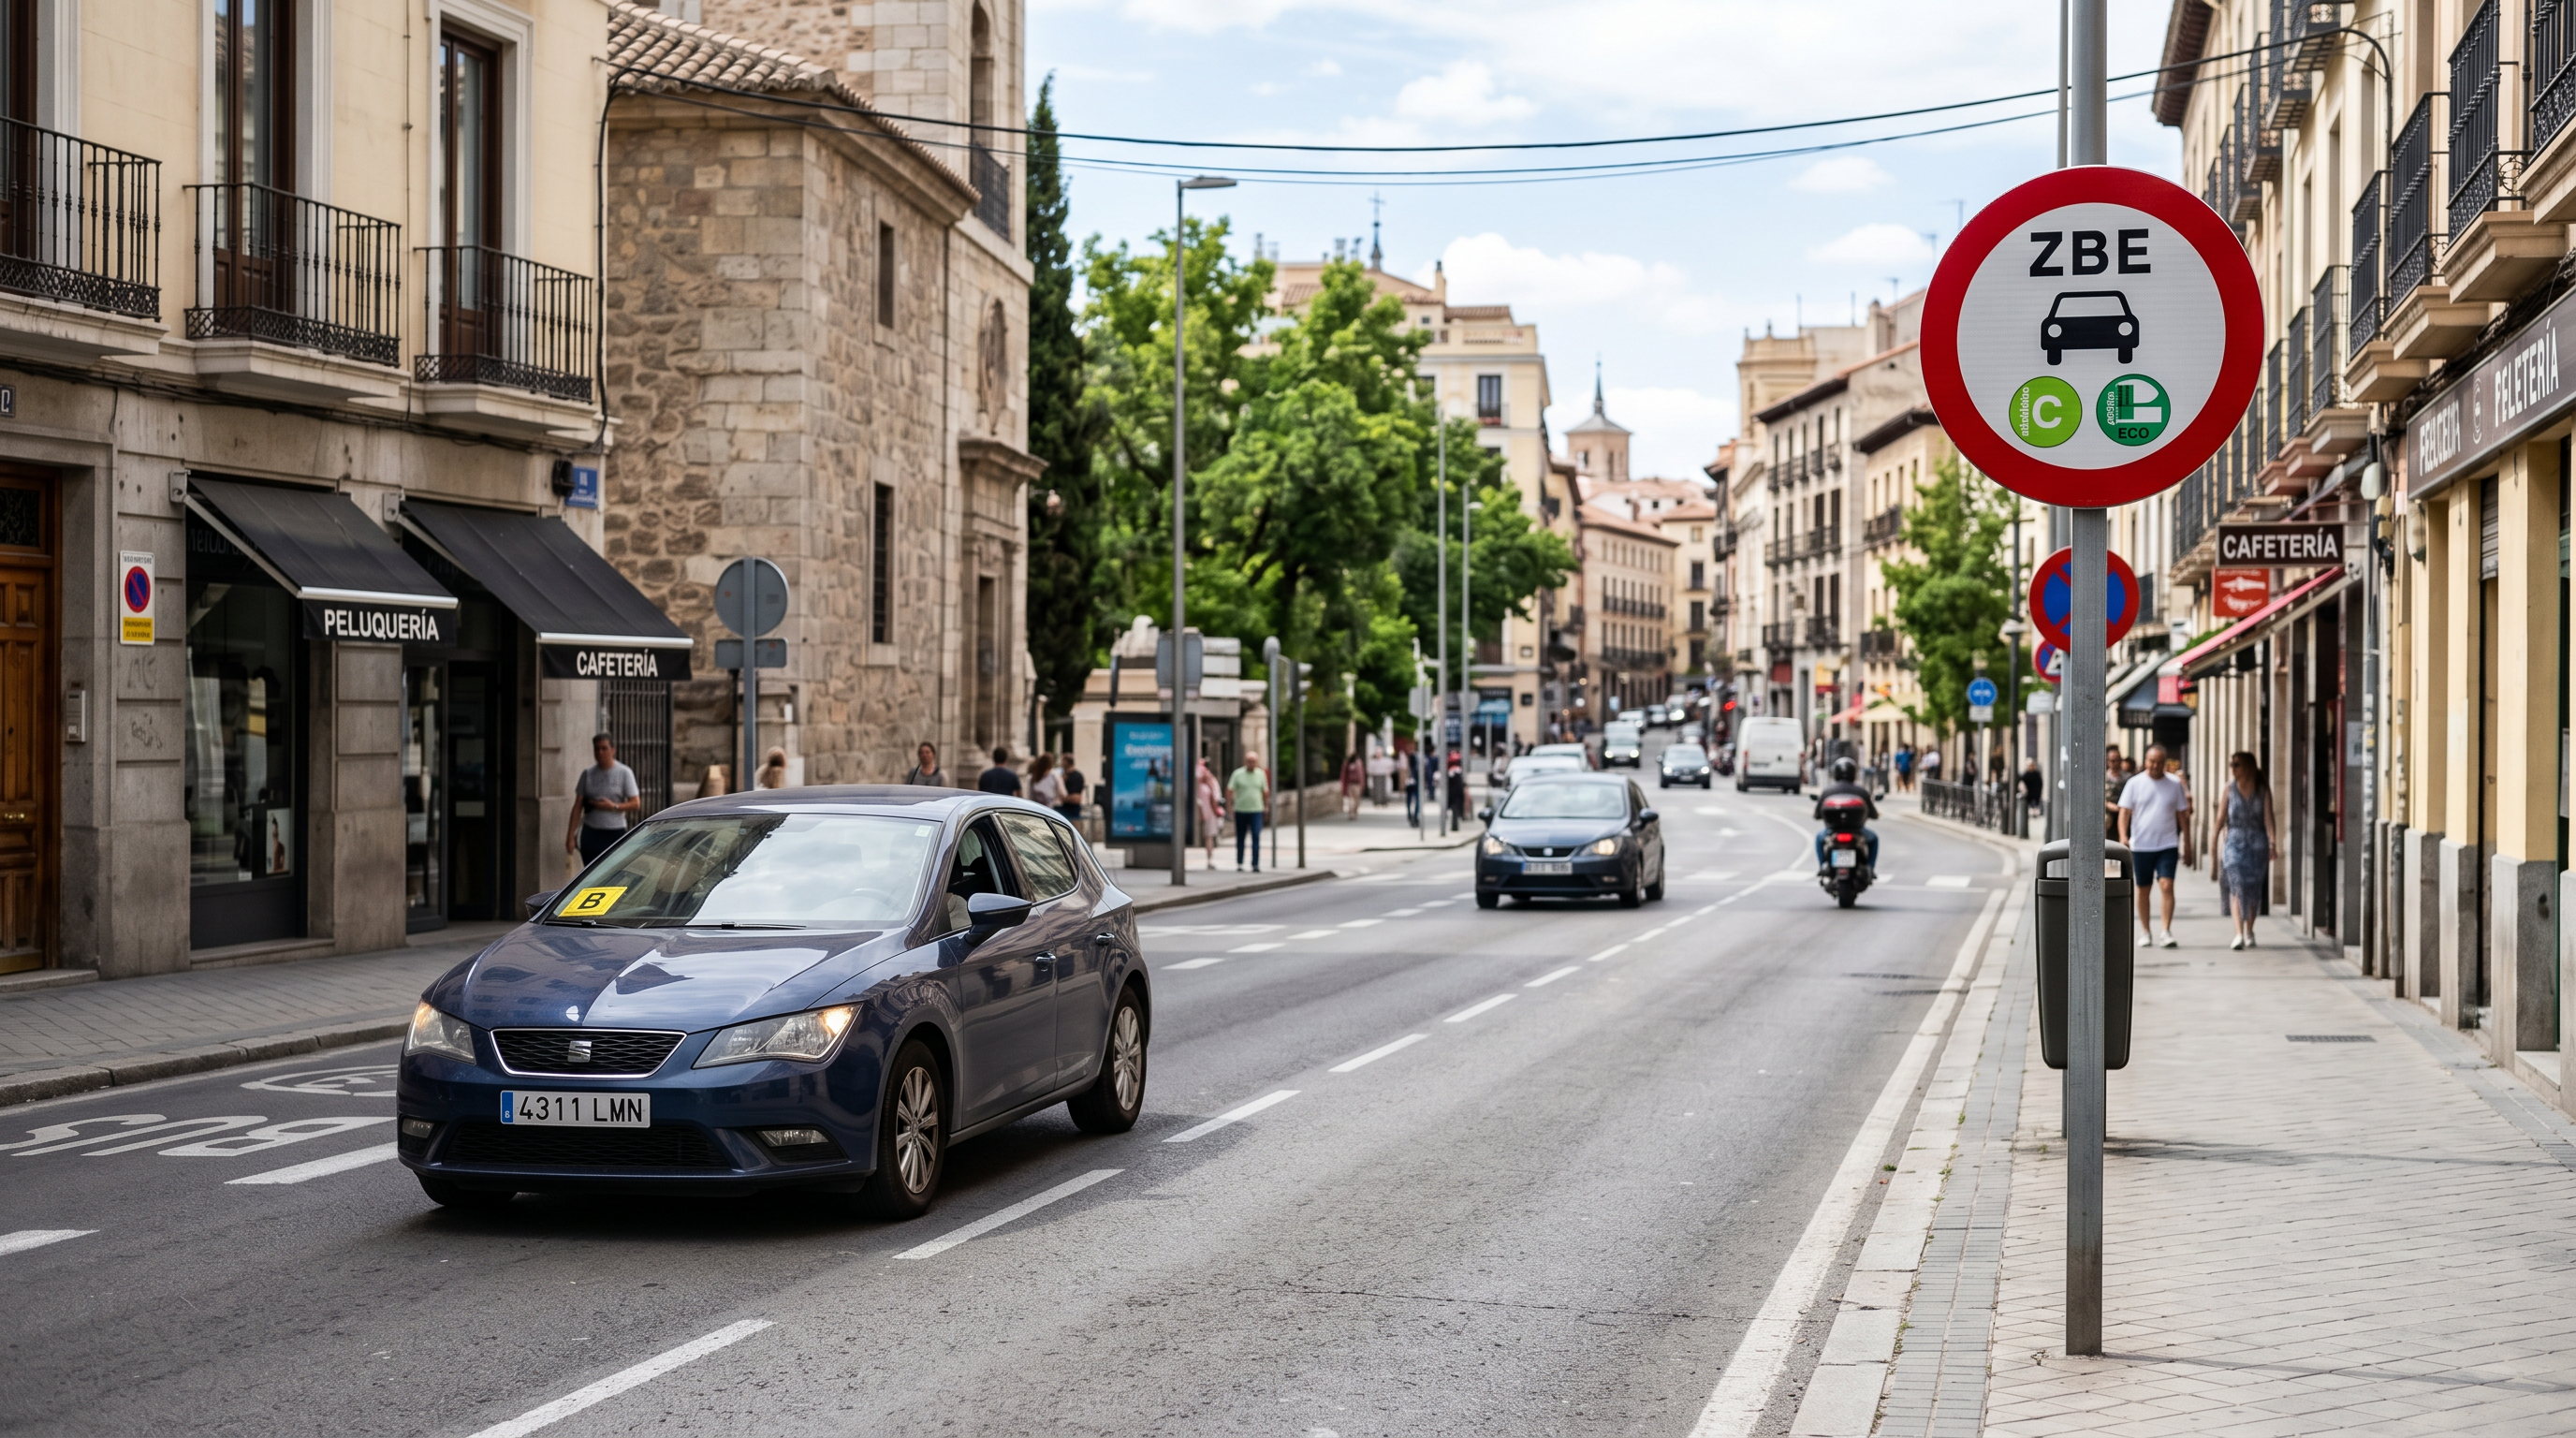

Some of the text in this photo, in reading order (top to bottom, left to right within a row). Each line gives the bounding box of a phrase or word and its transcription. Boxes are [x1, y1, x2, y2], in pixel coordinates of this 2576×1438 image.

[2029, 228, 2151, 277] ZBE
[2032, 394, 2062, 429] C
[2118, 427, 2149, 439] ECO
[2223, 527, 2338, 559] CAFETERÍA
[324, 608, 440, 641] PELUQUERÍA
[577, 649, 658, 677] CAFETERÍA
[578, 892, 607, 909] B
[519, 1095, 579, 1122] 4311
[593, 1097, 642, 1123] LMN
